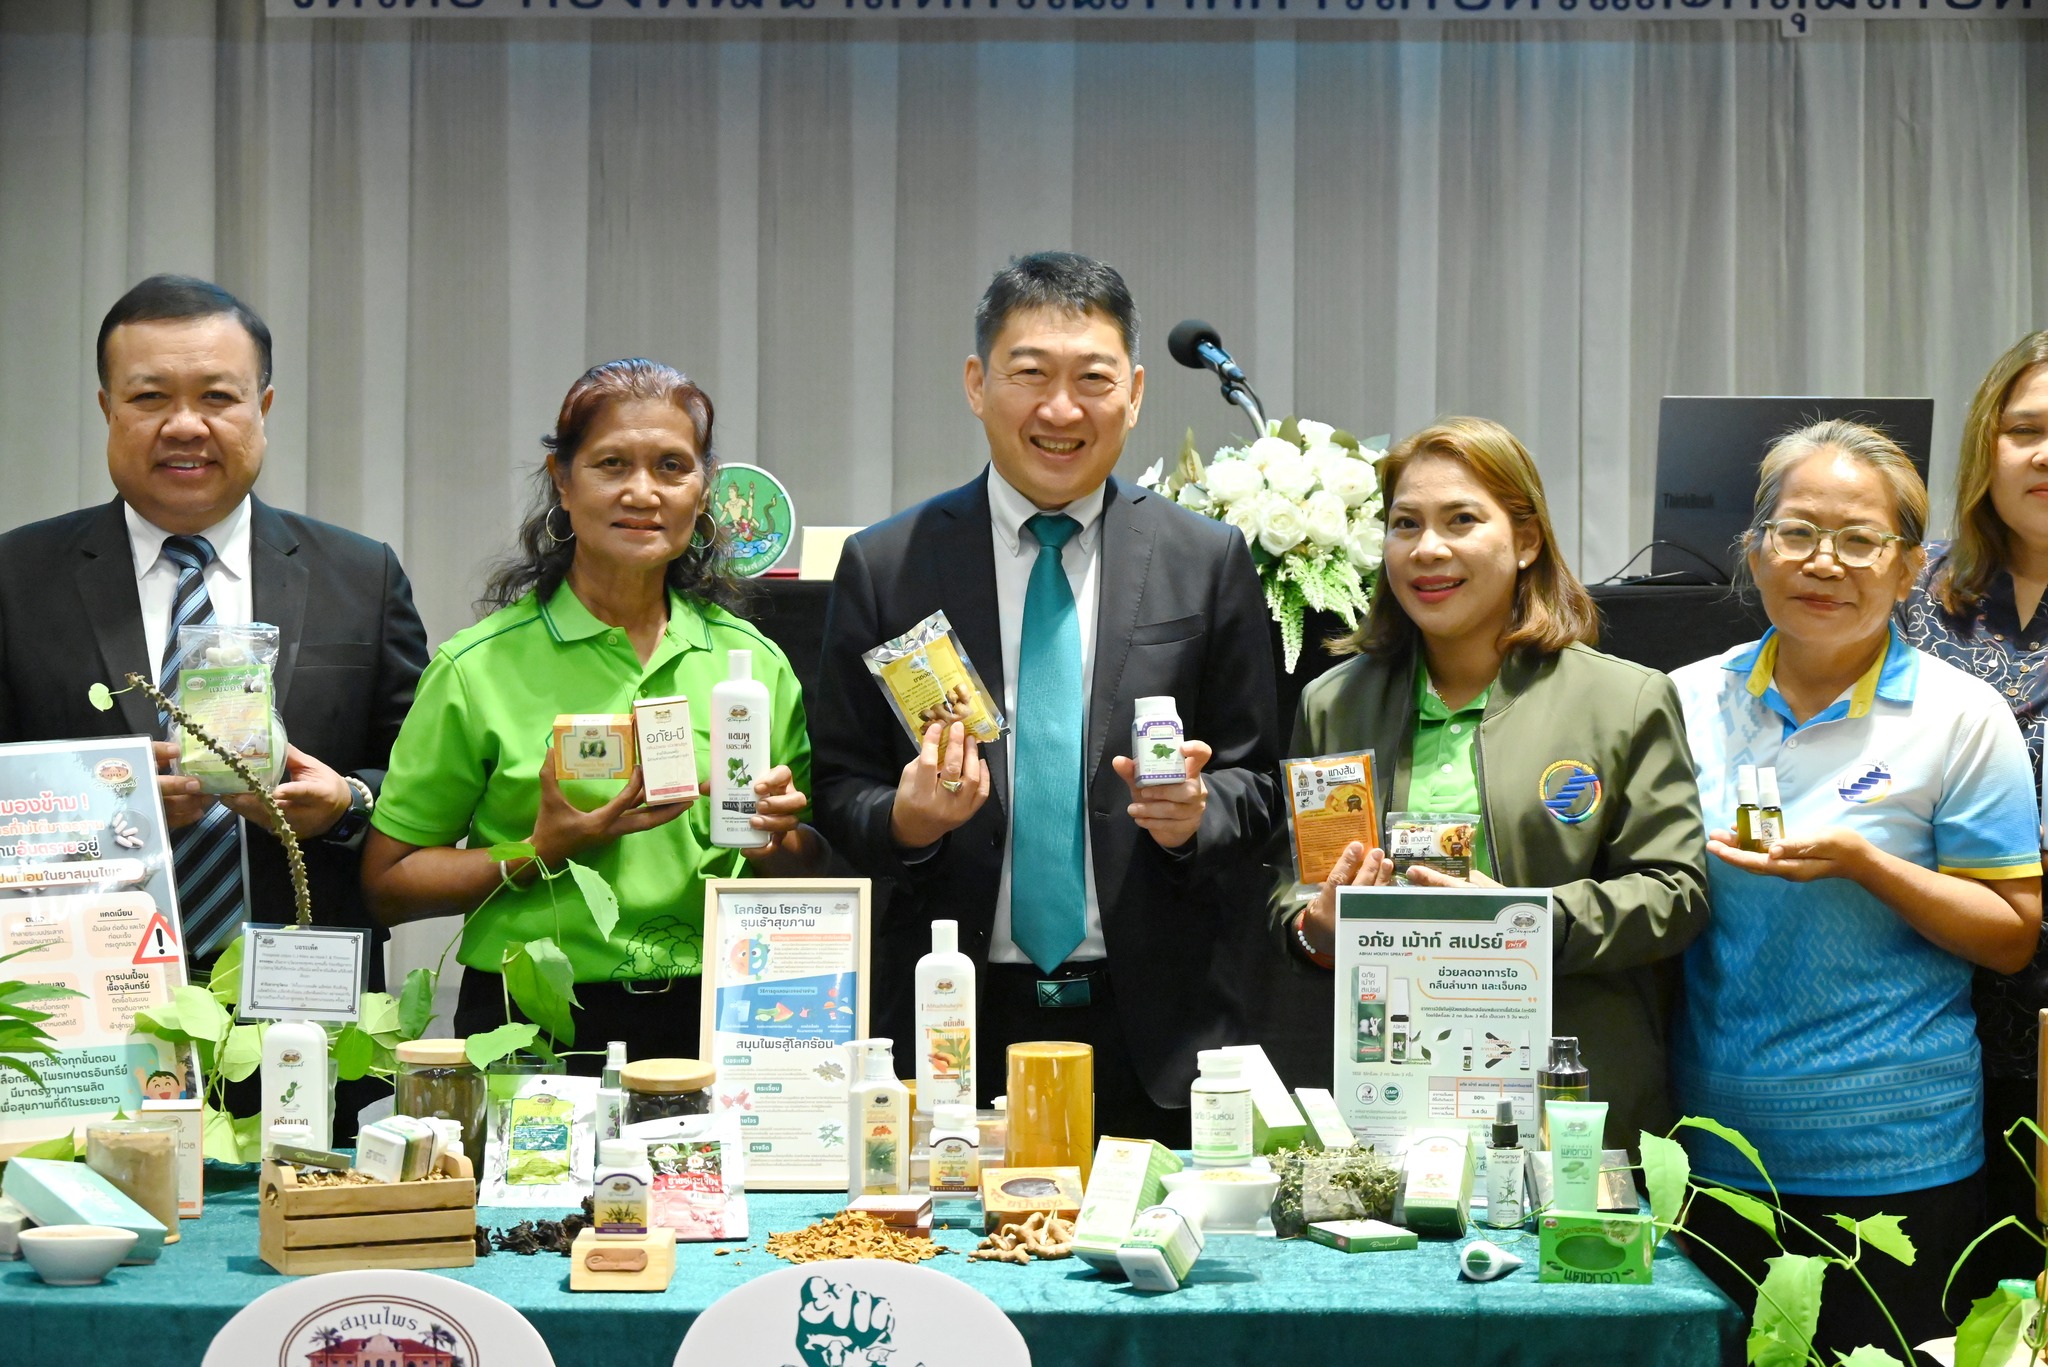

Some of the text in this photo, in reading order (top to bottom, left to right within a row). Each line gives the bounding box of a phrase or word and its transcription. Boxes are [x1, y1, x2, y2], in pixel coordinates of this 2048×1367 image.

[646, 726, 686, 744] อภัย-บี
[728, 732, 750, 742] แชมพู
[1328, 765, 1356, 776] แกงส้ม
[734, 903, 822, 915] โลกร้อน โรคร้าย
[740, 916, 815, 930] รุมเร้าสุขภาพ
[1358, 930, 1394, 948] อภัย
[1402, 930, 1442, 948] เม้าท์
[1449, 932, 1504, 949] สเปรย์
[1438, 966, 1518, 977] ช่วยลดอาการไอ
[1429, 980, 1528, 991] กลืนลำบาก และเจ็บคอ
[736, 1037, 834, 1052] สมุนไพรสู้โลกร้อน
[1563, 1269, 1621, 1284] แตงกวา
[340, 1305, 420, 1331] สมุนไพร
